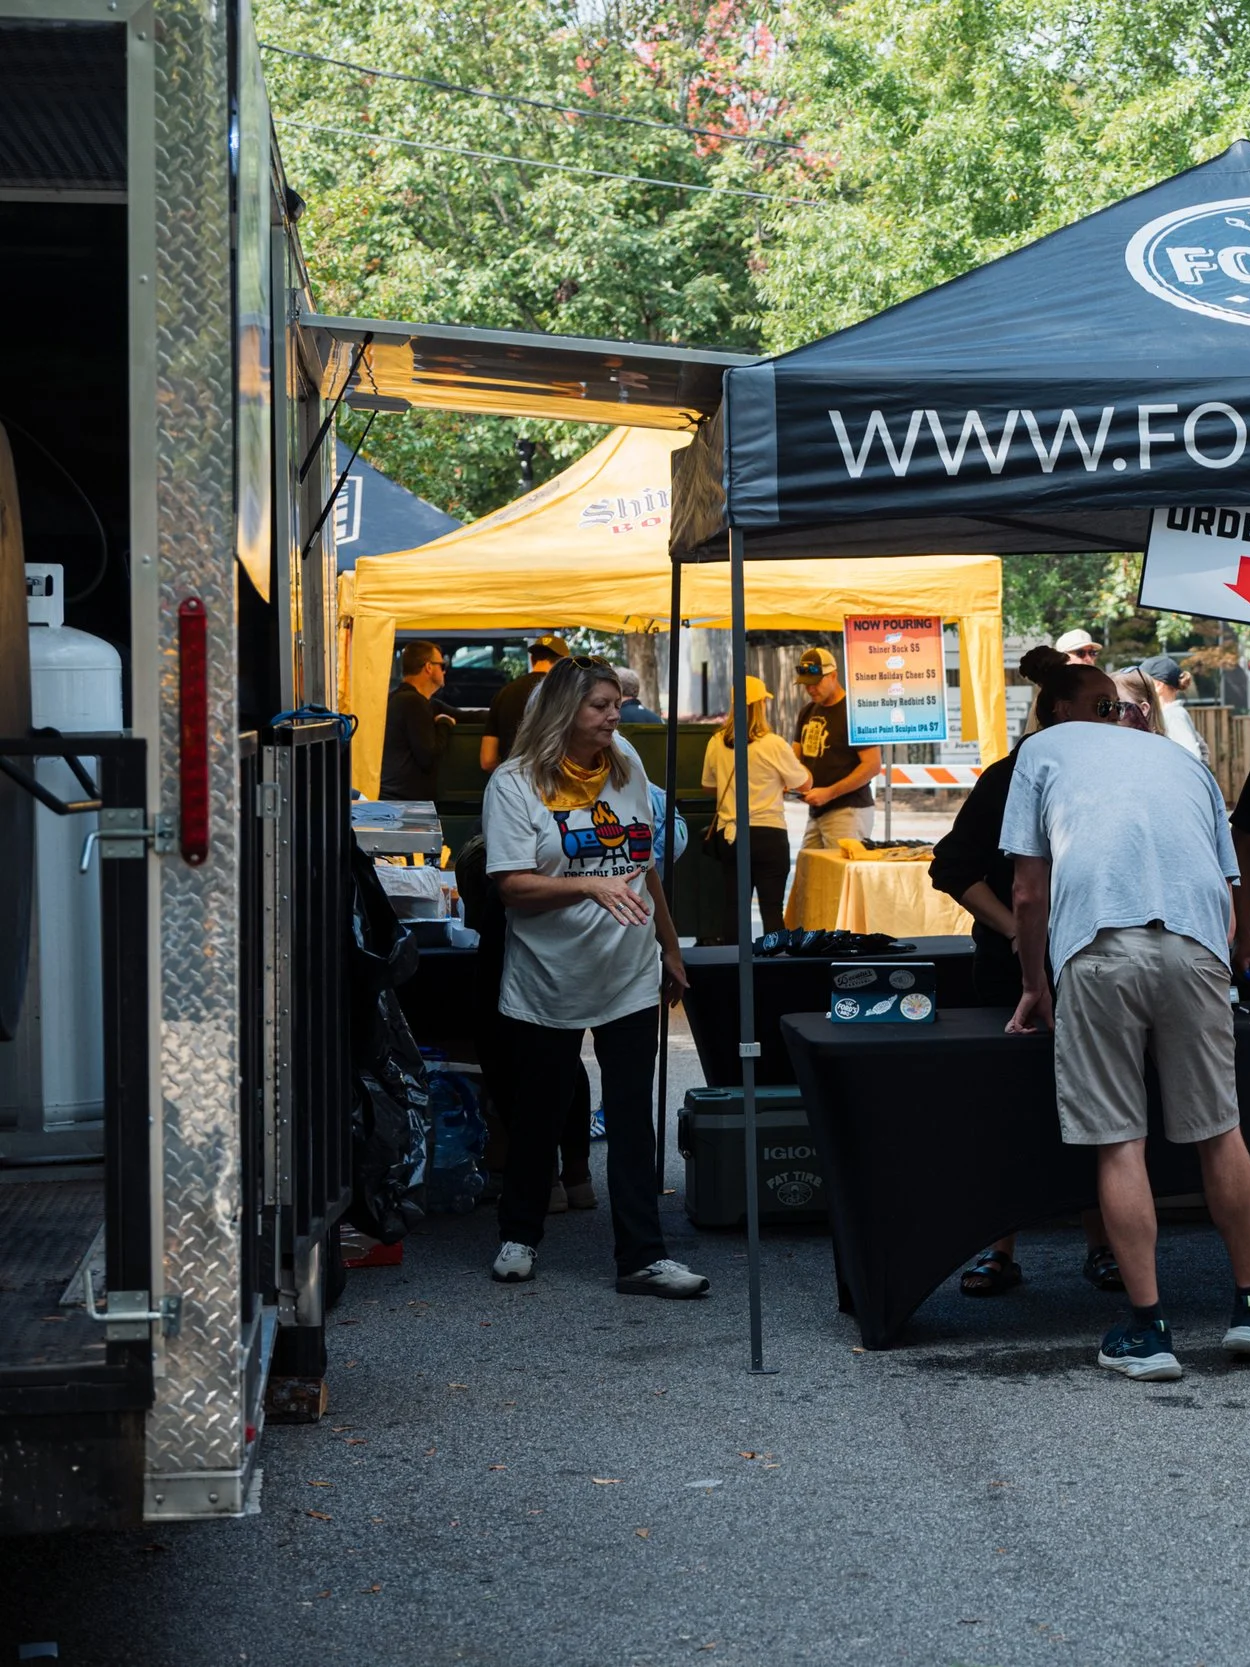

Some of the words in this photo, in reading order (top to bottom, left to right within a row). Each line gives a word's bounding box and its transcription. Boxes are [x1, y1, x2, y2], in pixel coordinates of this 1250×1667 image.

[854, 620, 880, 631] NOW
[883, 618, 932, 630] POURING
[868, 645, 890, 654] Shiner
[892, 644, 908, 653] Bock
[910, 643, 920, 653] $5
[855, 672, 877, 681] Shiner
[879, 671, 903, 681] Holiday
[905, 670, 924, 680] Cheer
[926, 669, 936, 679] $5
[857, 699, 879, 708] Shiner
[881, 698, 897, 707] Ruby
[899, 697, 925, 706] Redbird
[926, 696, 936, 706] $5
[857, 726, 878, 735] Ballast
[879, 725, 894, 733] Point
[895, 724, 916, 734] Sculpin
[918, 724, 928, 732] IPA
[929, 722, 939, 732] $7
[612, 864, 634, 876] BBQ
[766, 1172, 789, 1190] FAT
[793, 1170, 823, 1188] TIRE
